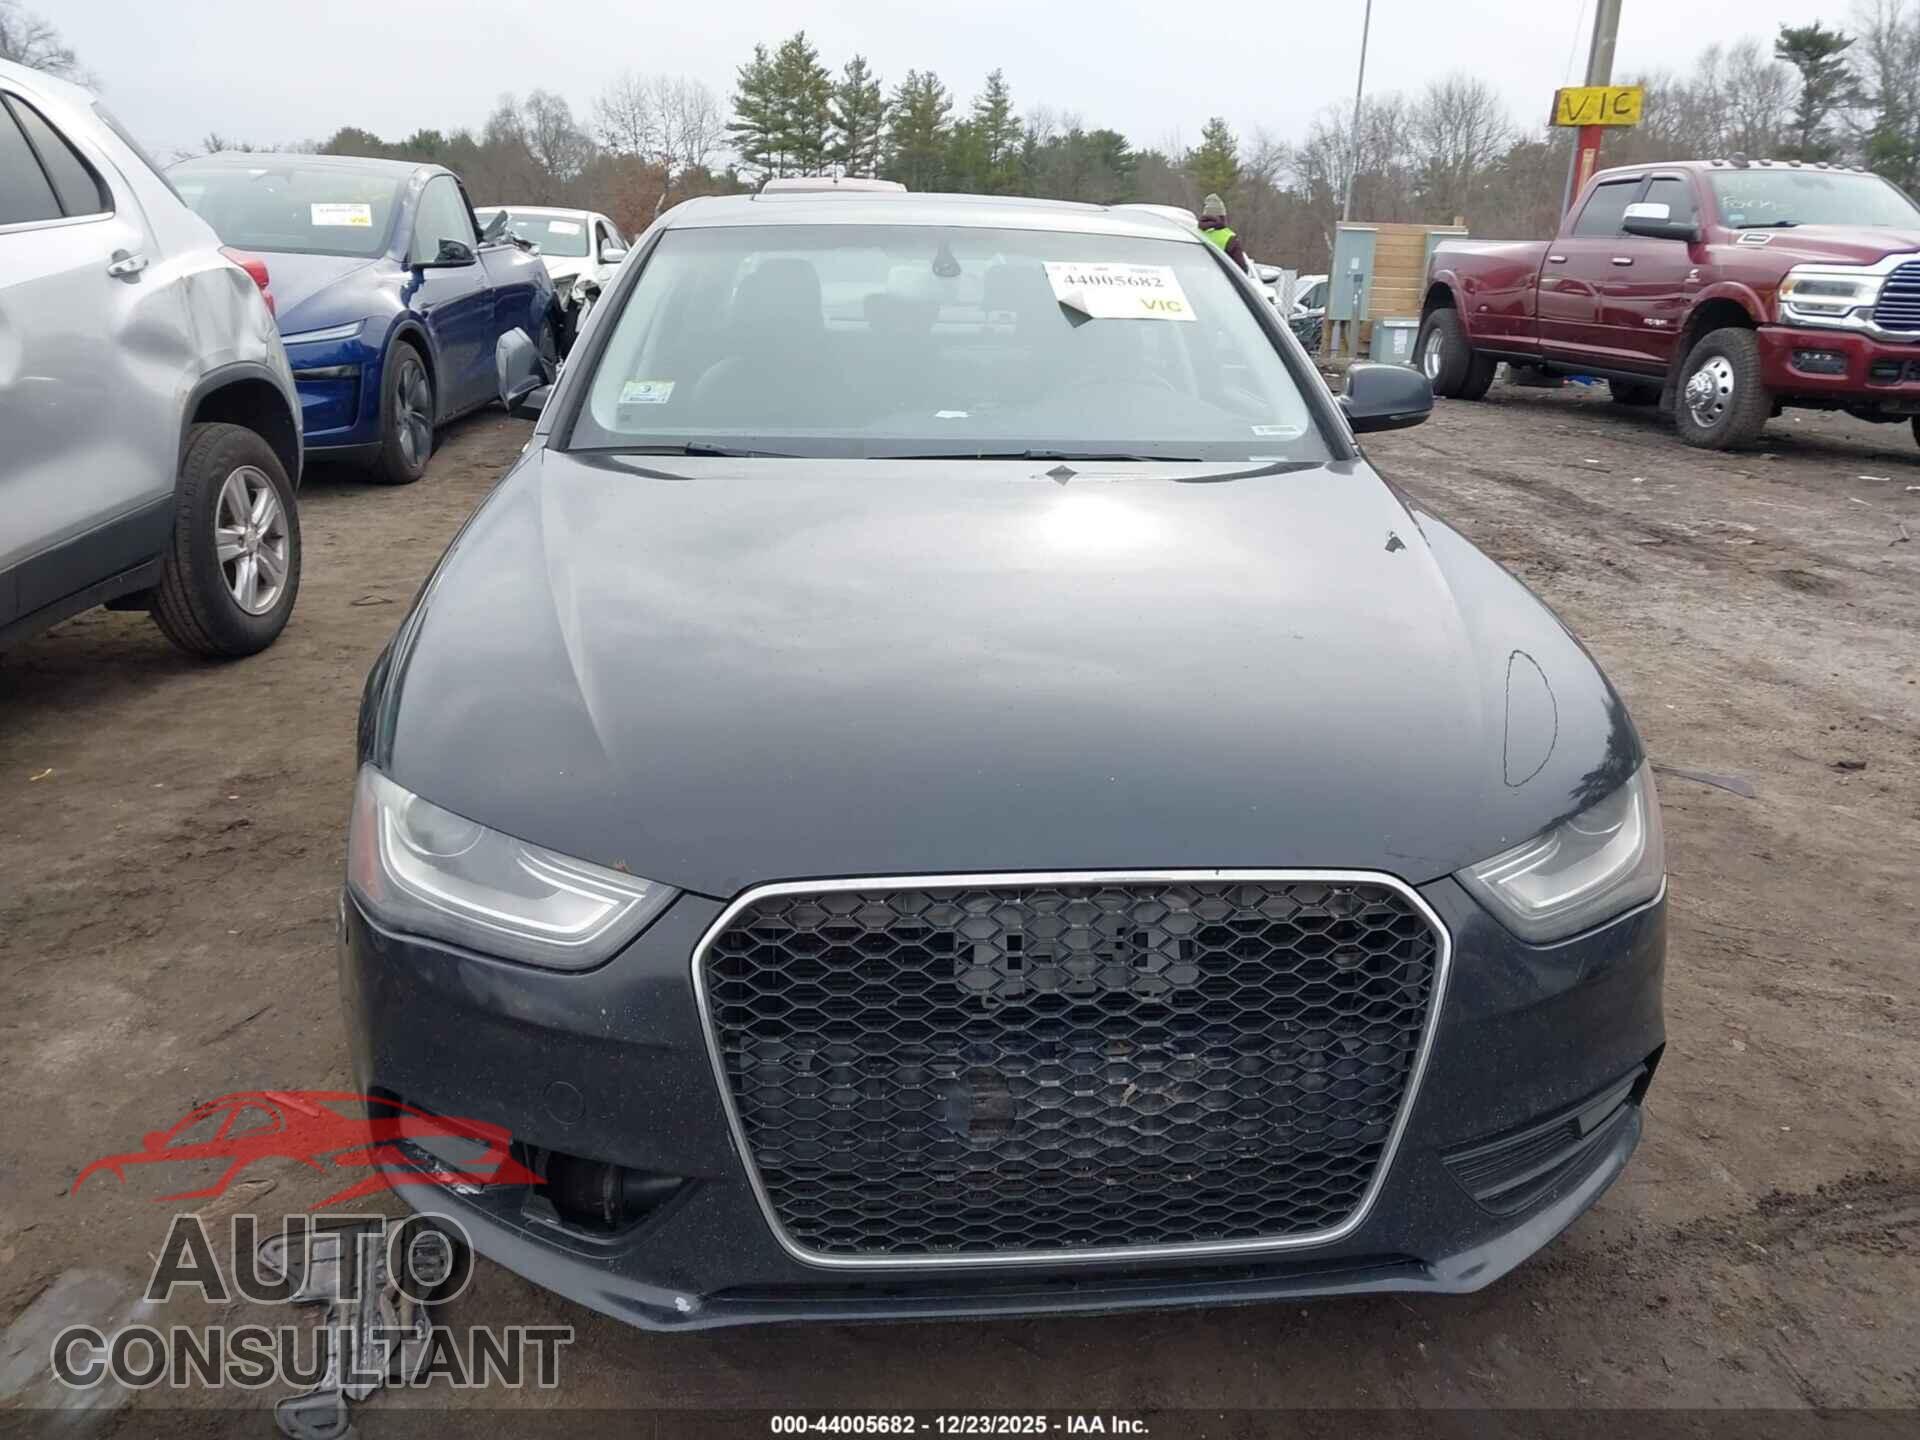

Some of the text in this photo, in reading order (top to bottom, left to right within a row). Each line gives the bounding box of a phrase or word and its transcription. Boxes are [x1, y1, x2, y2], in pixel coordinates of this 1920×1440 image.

[1566, 92, 1630, 121] VIC
[1064, 274, 1165, 288] 44005682
[1141, 298, 1183, 313] VIC
